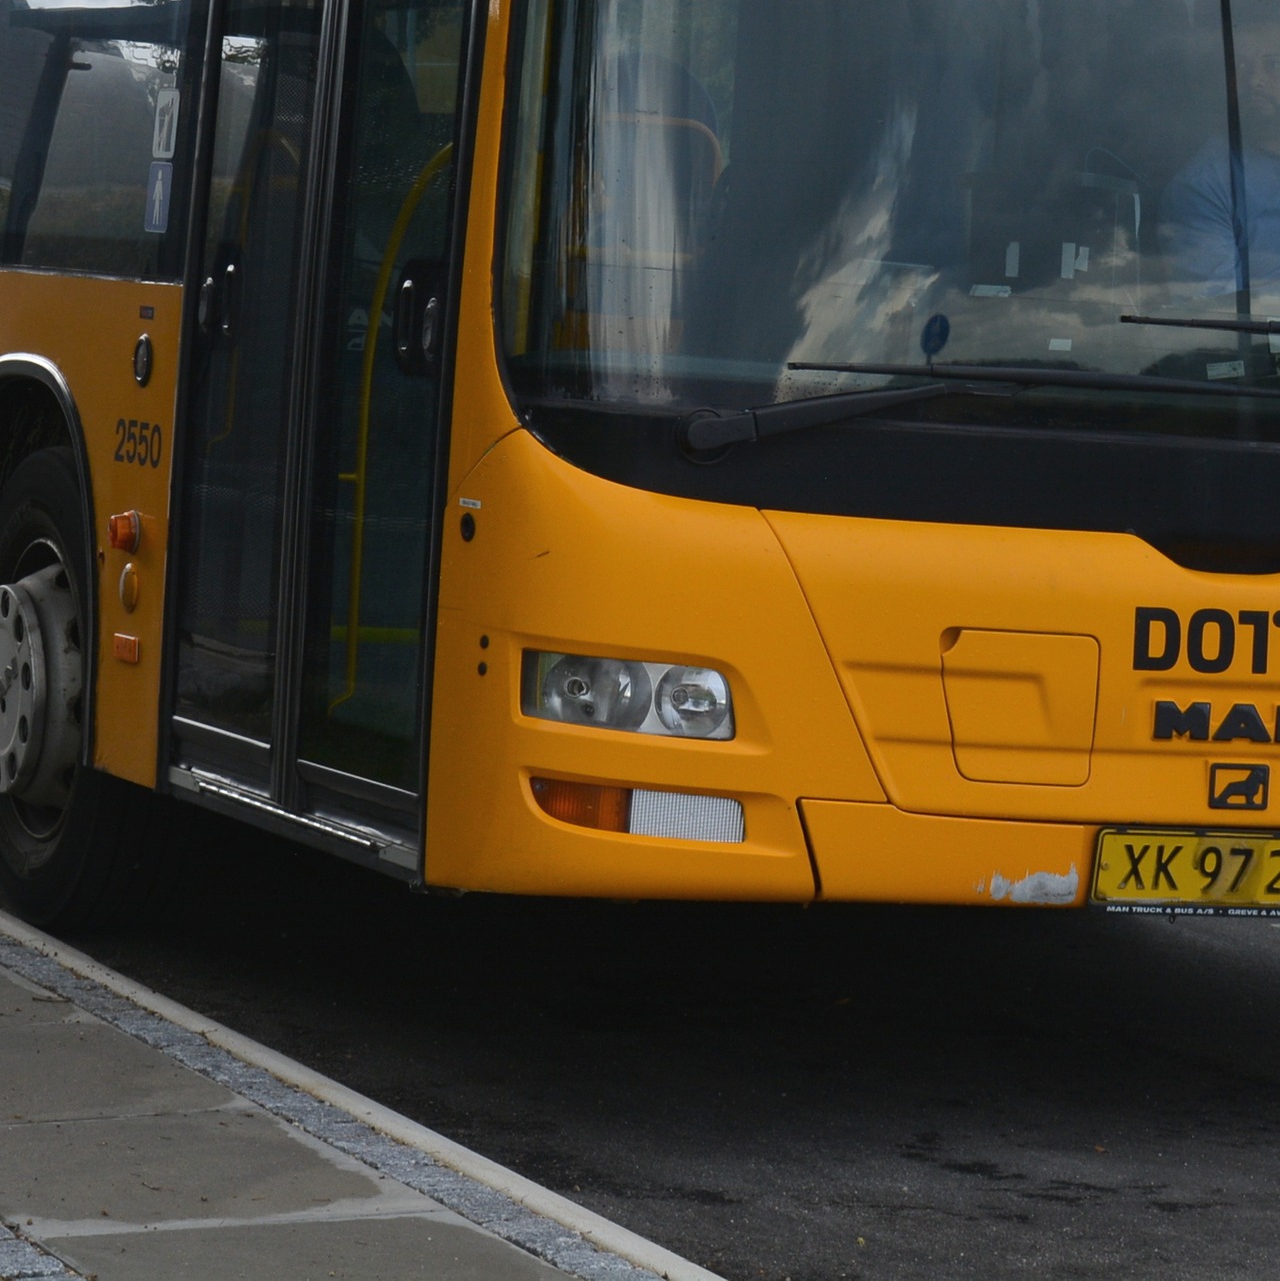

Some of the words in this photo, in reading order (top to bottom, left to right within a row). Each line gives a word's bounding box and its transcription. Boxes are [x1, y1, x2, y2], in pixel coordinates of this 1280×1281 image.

[114, 419, 162, 469] 2550
[1133, 607, 1272, 674] DOT
[1118, 844, 1184, 890] XK
[1198, 846, 1255, 893] 97
[1106, 905, 1130, 913] MAN
[1132, 906, 1163, 914] TRUCK
